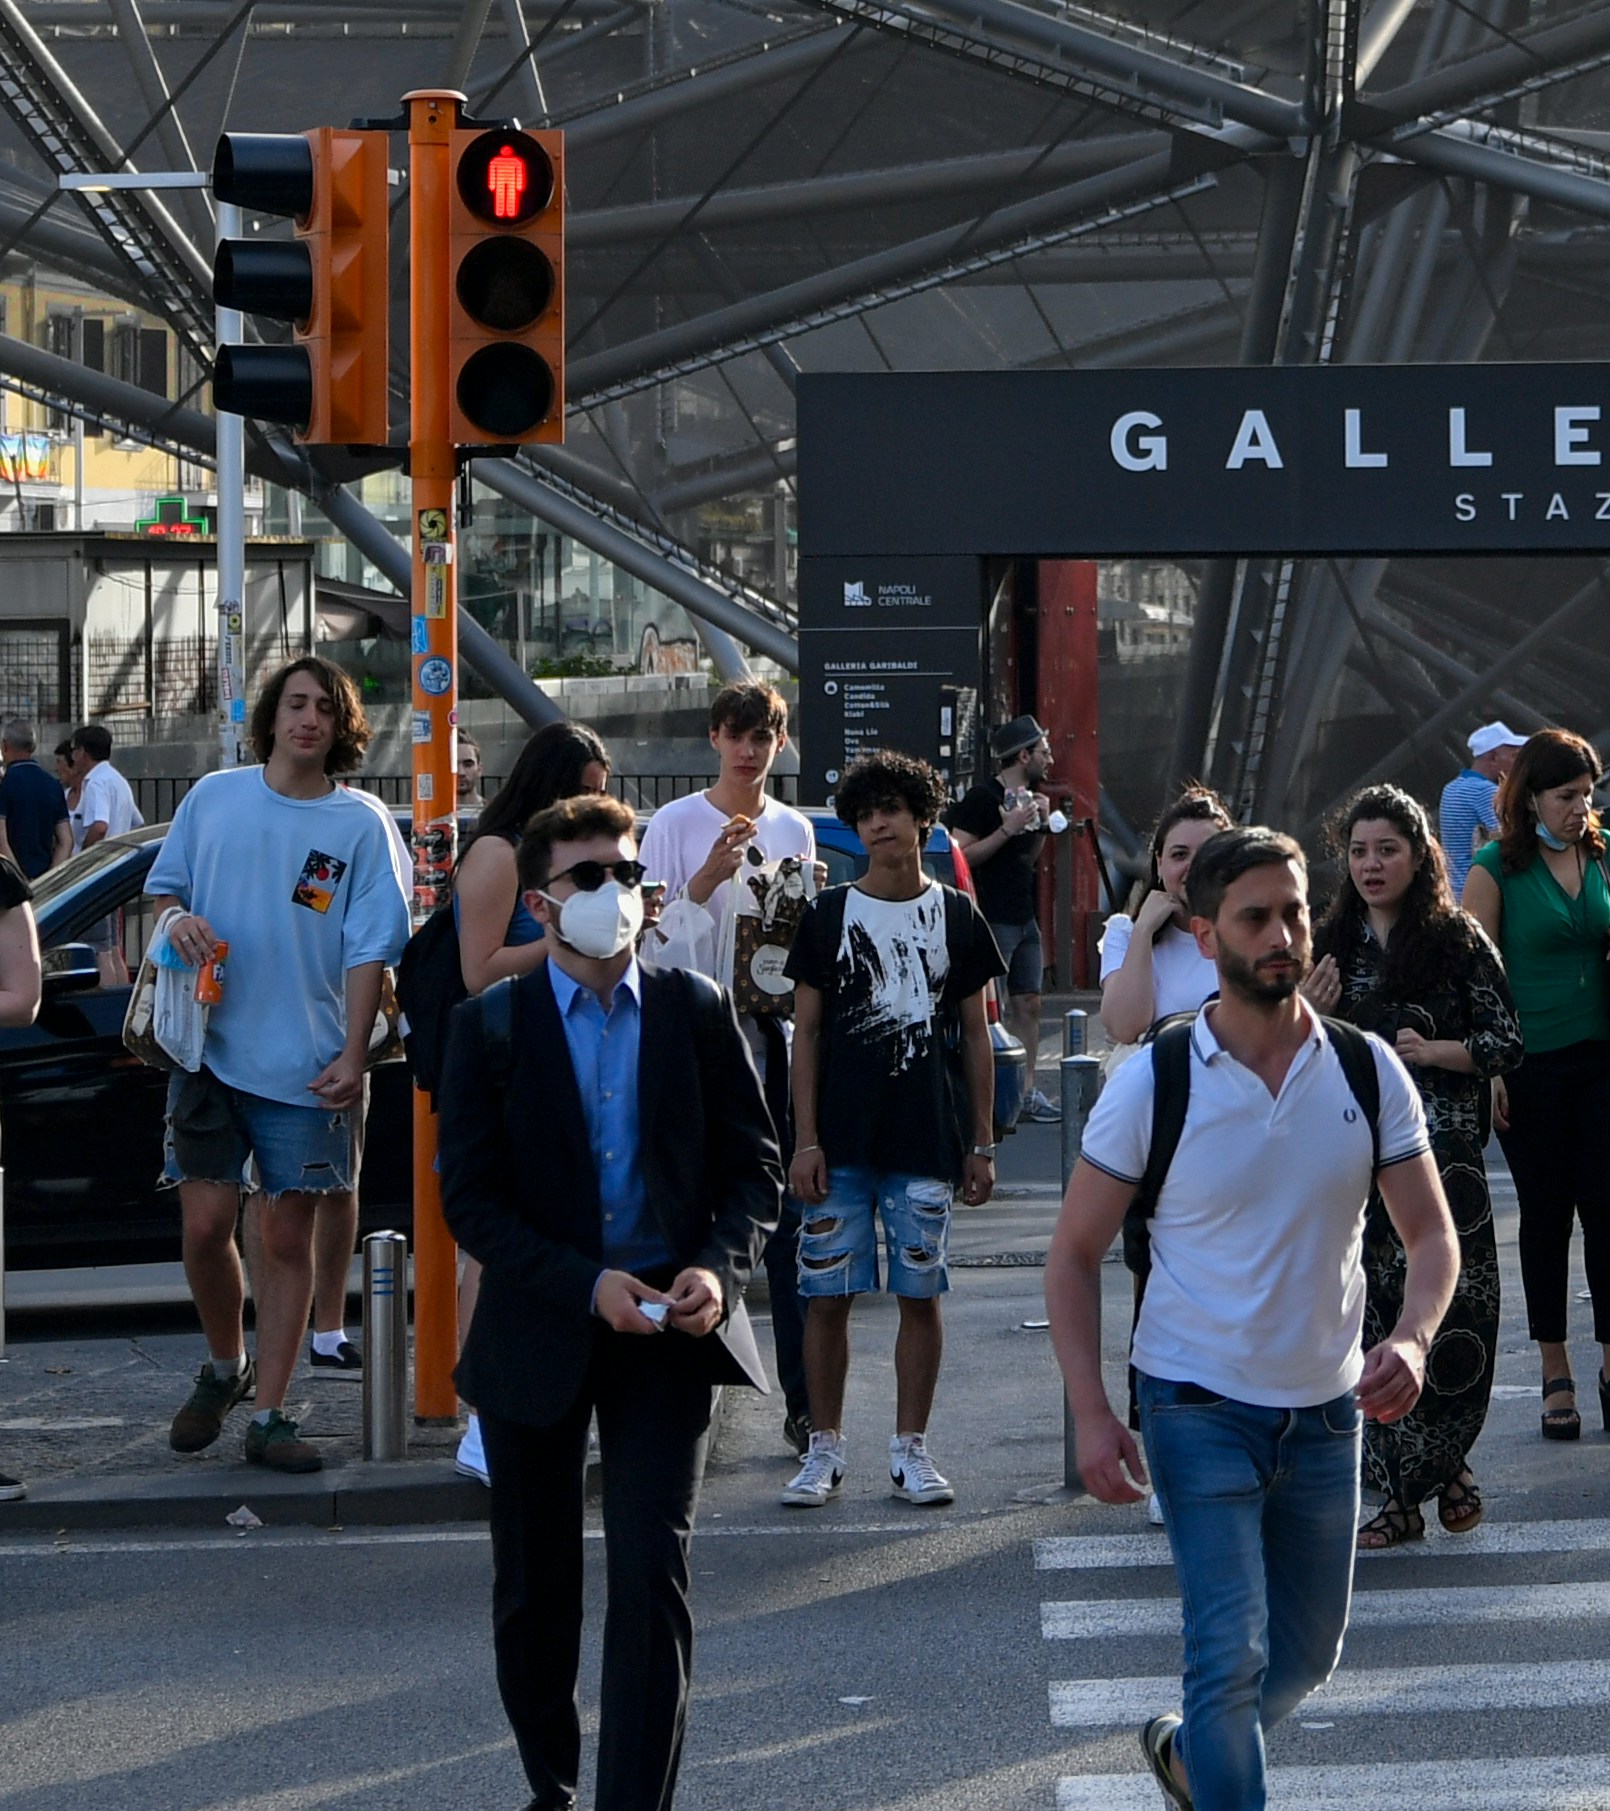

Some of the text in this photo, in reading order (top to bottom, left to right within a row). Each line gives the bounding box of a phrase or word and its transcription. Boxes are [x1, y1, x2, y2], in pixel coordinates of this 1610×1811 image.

[878, 585, 917, 595] NAPOLI
[878, 596, 932, 606] CENTRALE
[823, 661, 918, 671] GALLERIA GARIBALDI
